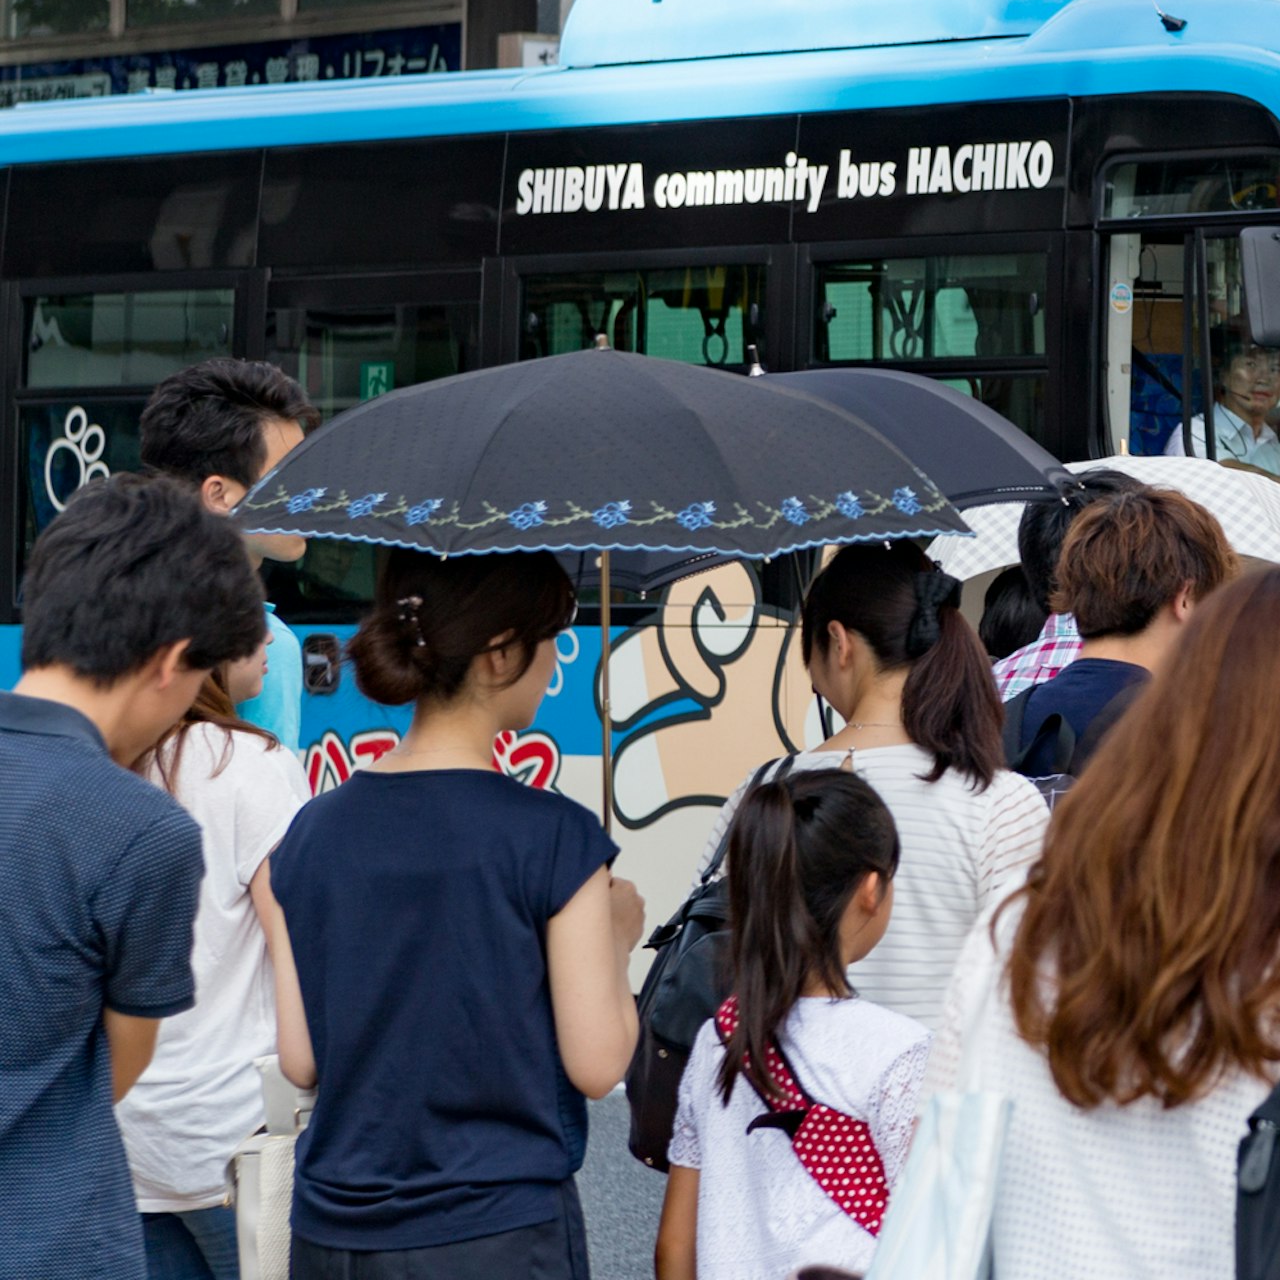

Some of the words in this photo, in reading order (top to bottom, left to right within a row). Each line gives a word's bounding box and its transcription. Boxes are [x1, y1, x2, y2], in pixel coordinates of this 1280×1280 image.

[515, 162, 646, 216] SHIBUYA
[653, 150, 829, 214] community
[837, 148, 897, 200] bus
[906, 139, 1054, 196] HACHIKO
